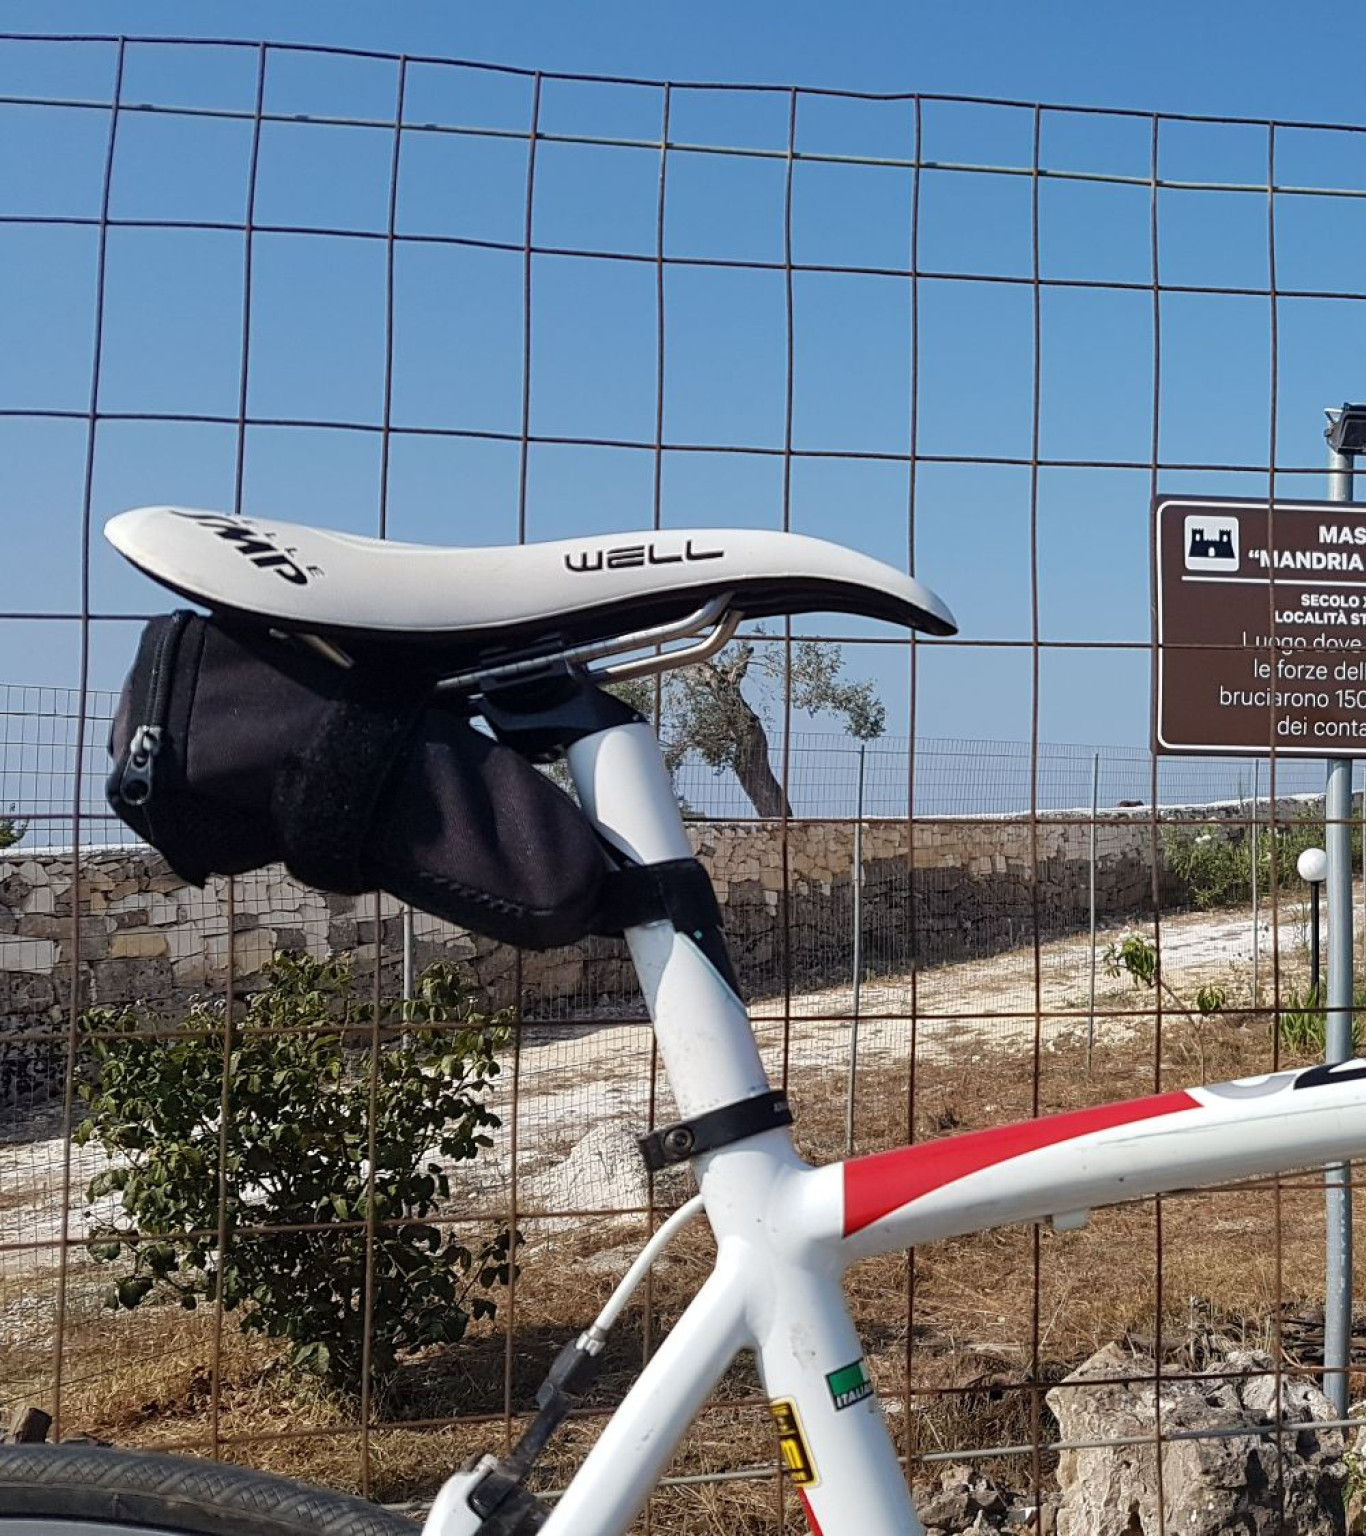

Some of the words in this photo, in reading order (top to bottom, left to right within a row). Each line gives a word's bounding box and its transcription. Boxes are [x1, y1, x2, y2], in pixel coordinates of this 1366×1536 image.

[564, 539, 725, 573] WELL
[1300, 593, 1360, 608] SECOLO
[1274, 609, 1348, 625] LOCALITÀ
[1312, 632, 1362, 654] dove
[1254, 657, 1271, 678] le
[1276, 658, 1328, 680] forze
[1219, 685, 1330, 707] bruciarono
[1276, 714, 1308, 736] dei
